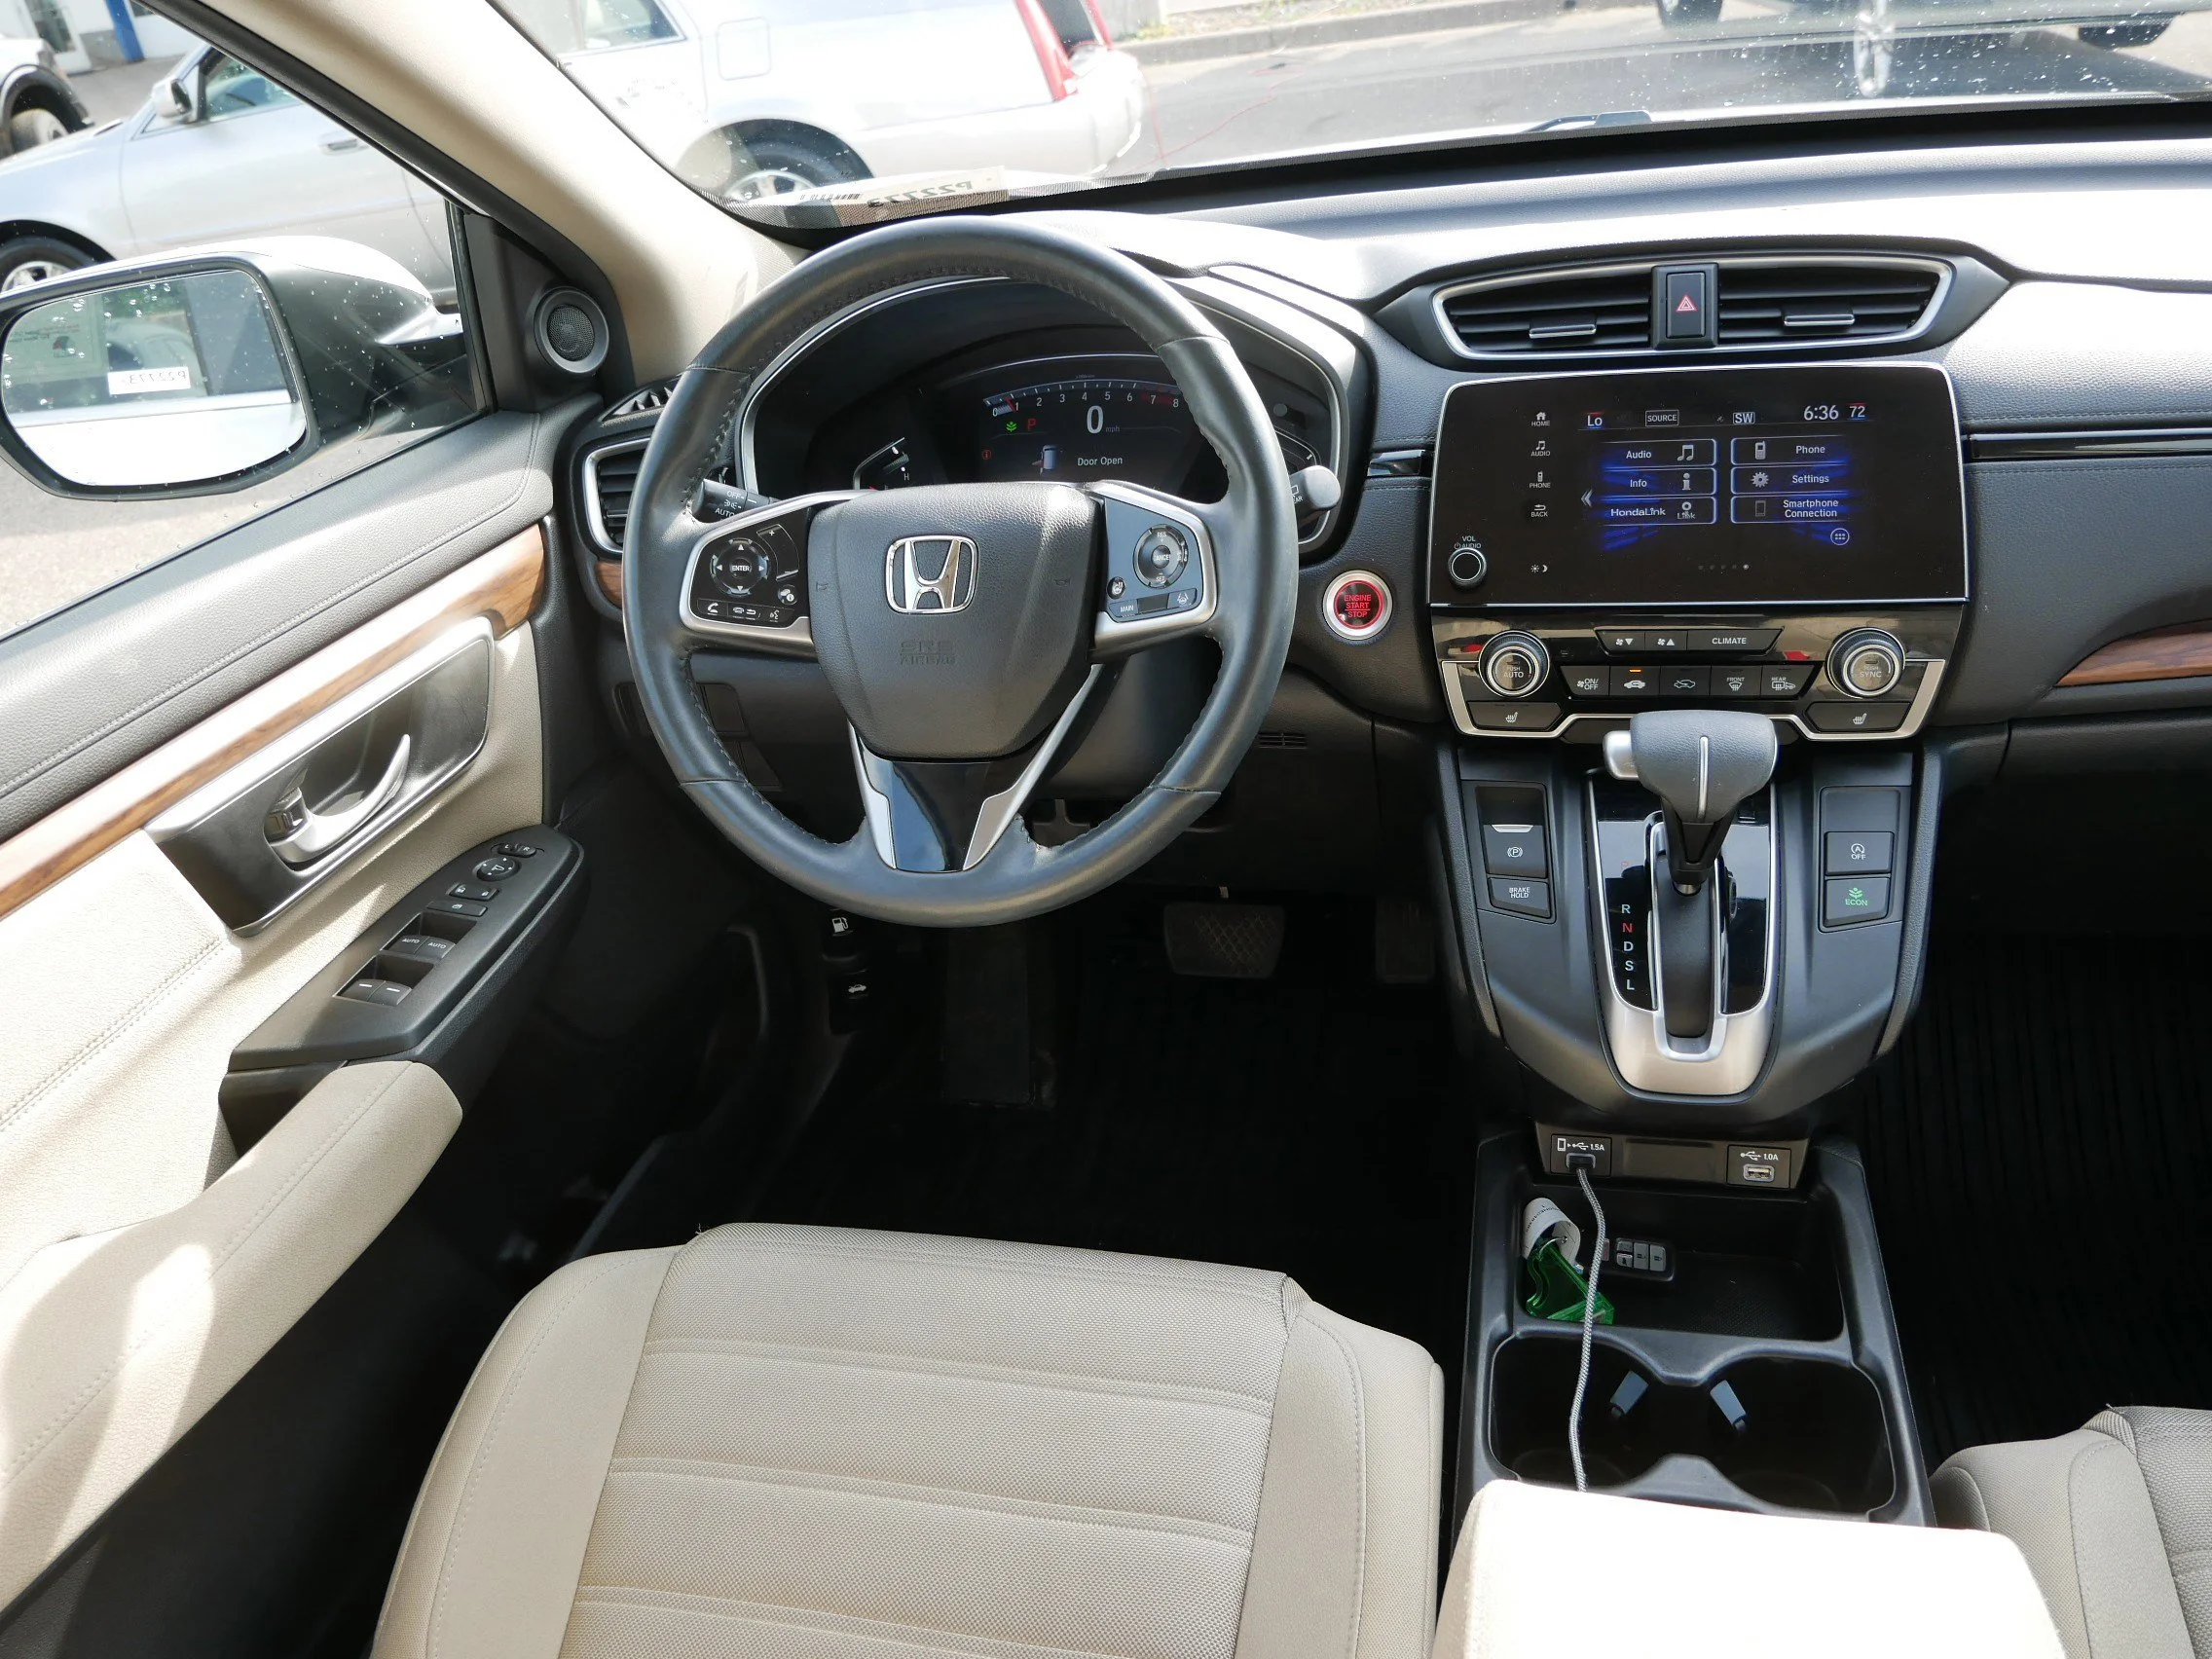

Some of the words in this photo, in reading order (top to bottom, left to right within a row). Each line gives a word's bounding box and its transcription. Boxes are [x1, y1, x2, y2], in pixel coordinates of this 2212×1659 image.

[992, 407, 998, 417] 0
[1036, 397, 1043, 407] 2
[1059, 393, 1066, 403] 3
[1082, 391, 1088, 401] 4
[1104, 391, 1111, 400] 5
[1126, 392, 1133, 402] 6
[1151, 395, 1157, 405] 7
[1172, 398, 1179, 408] 8
[1803, 405, 1839, 421] 6:36
[1849, 406, 1865, 418] 72
[1087, 405, 1104, 434] 0
[1105, 424, 1120, 433] mph
[1587, 415, 1603, 426] Lo
[1647, 414, 1677, 423] SOURCE
[1734, 413, 1753, 424] SW
[1027, 418, 1037, 431] P
[1626, 450, 1652, 459] Audio
[1795, 445, 1825, 455] Phone
[1077, 457, 1097, 466] Door
[1100, 456, 1123, 467] Open
[903, 472, 910, 481] H
[1792, 474, 1829, 484] Settings
[1630, 479, 1647, 488] Info
[726, 490, 741, 499] OFF
[1783, 498, 1839, 508] Smartphone
[1610, 507, 1666, 517] HondaLink
[1785, 508, 1838, 518] Connection
[1621, 903, 1631, 914] R
[1622, 922, 1634, 933] N
[1623, 940, 1634, 951] D
[1624, 960, 1635, 972] S
[1626, 978, 1636, 990] L
